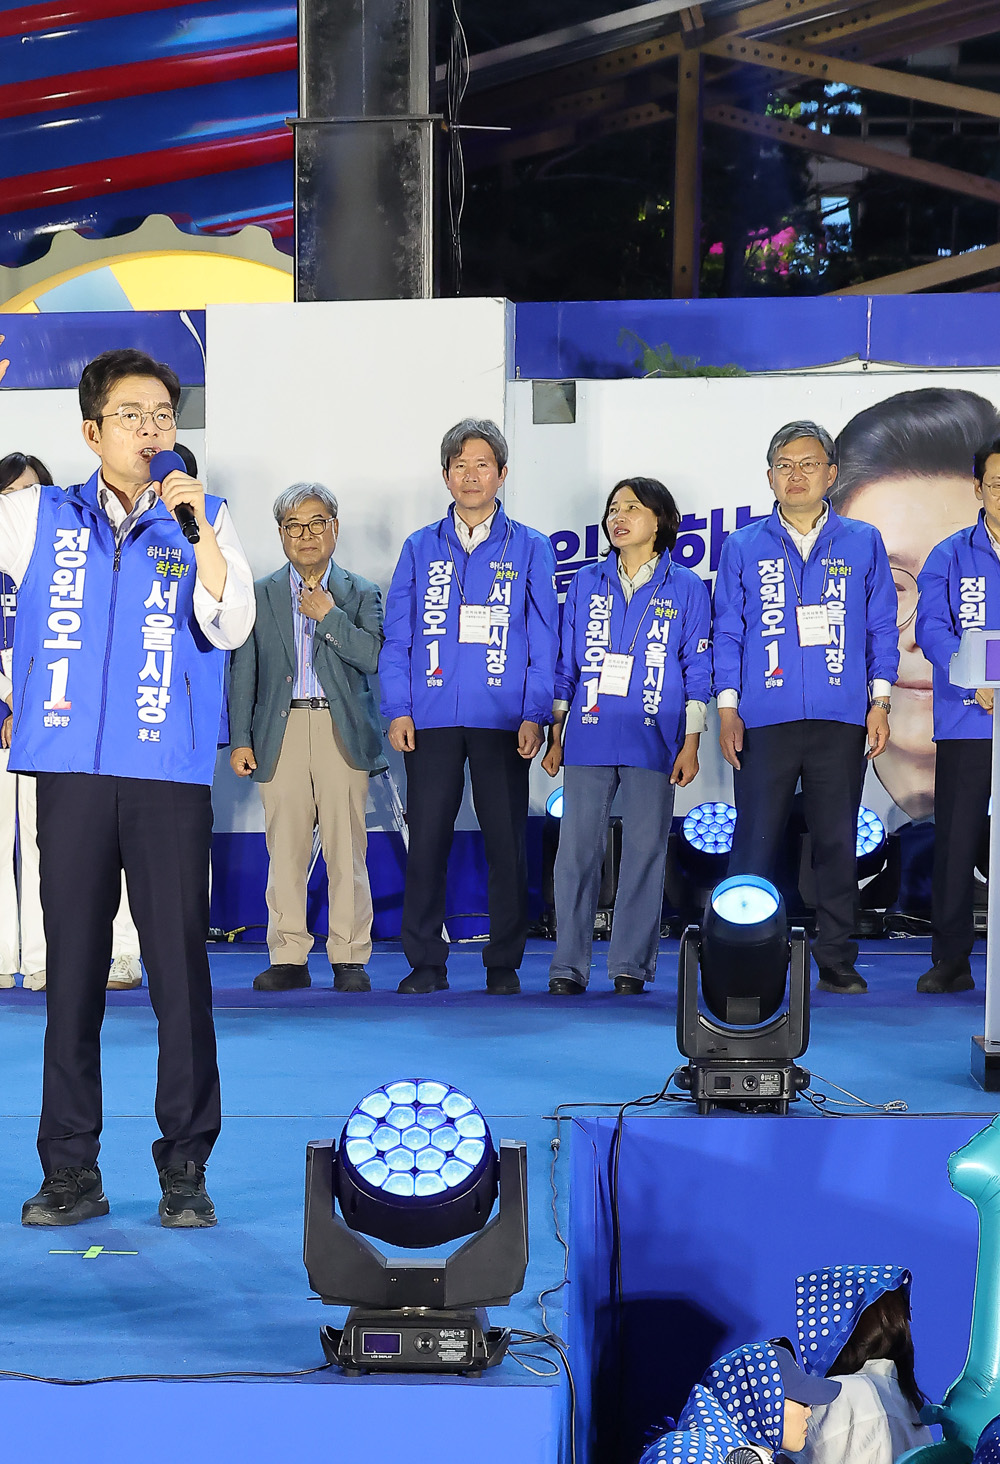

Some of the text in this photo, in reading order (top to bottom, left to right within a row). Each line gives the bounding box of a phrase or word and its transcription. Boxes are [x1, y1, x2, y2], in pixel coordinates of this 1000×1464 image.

[147, 545, 182, 562] 하나씩
[821, 558, 845, 566] 하나씩
[156, 560, 189, 579] 착착!
[489, 561, 513, 571] 하나씩
[496, 570, 518, 580] 착착!
[828, 566, 852, 576] 착착!
[654, 607, 678, 619] 착착!
[958, 576, 986, 632] 정원
[43, 527, 91, 710] 정원오 1
[423, 560, 453, 676] 정원오 1
[758, 557, 786, 678] 정원오 1
[824, 577, 846, 674] 서울시장
[485, 581, 511, 675] 서울시장
[135, 580, 179, 724] 서울시장
[580, 594, 614, 713] 정원오 1
[642, 620, 670, 715] 서울시장
[487, 677, 502, 687] 후보
[828, 677, 842, 686] 후보
[43, 714, 70, 727] 민주당
[137, 728, 161, 743] 후보
